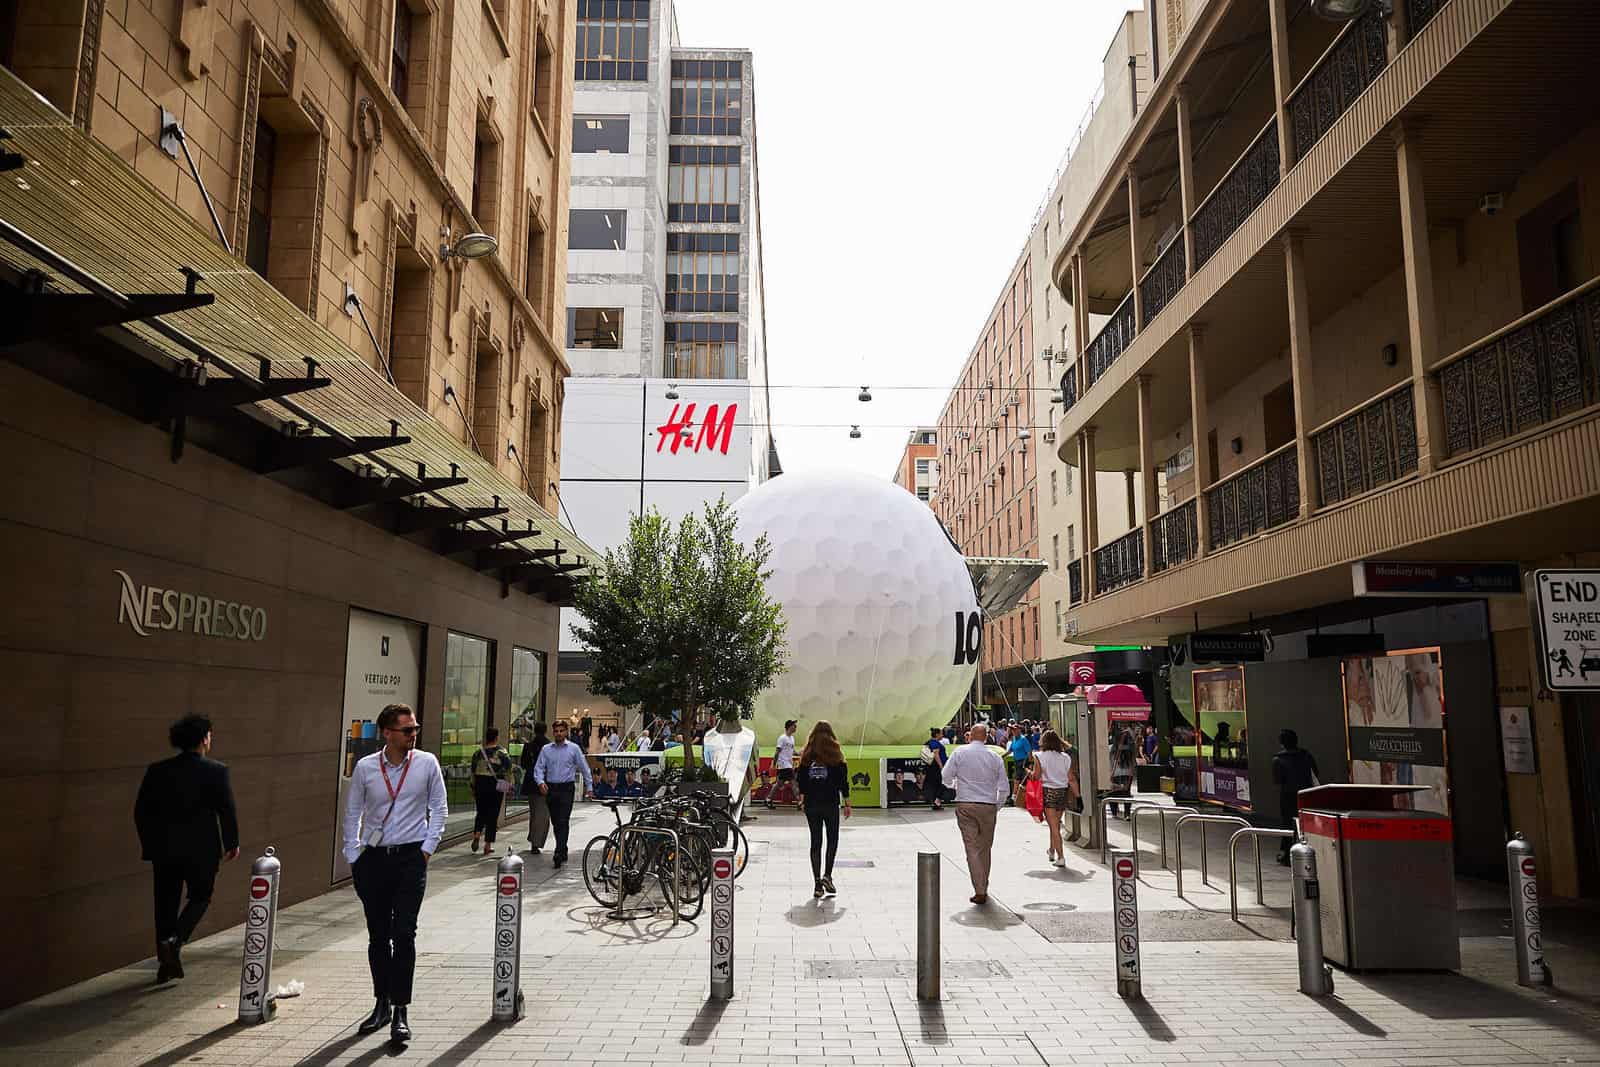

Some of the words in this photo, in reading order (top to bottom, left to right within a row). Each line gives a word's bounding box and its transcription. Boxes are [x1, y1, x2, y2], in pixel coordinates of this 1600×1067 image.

[657, 402, 737, 455] H&M
[1549, 582, 1598, 603] END
[113, 569, 267, 641] NESPRESSO
[1563, 630, 1597, 641] ZONE
[364, 673, 388, 685] VERTUO
[390, 675, 401, 686] POP
